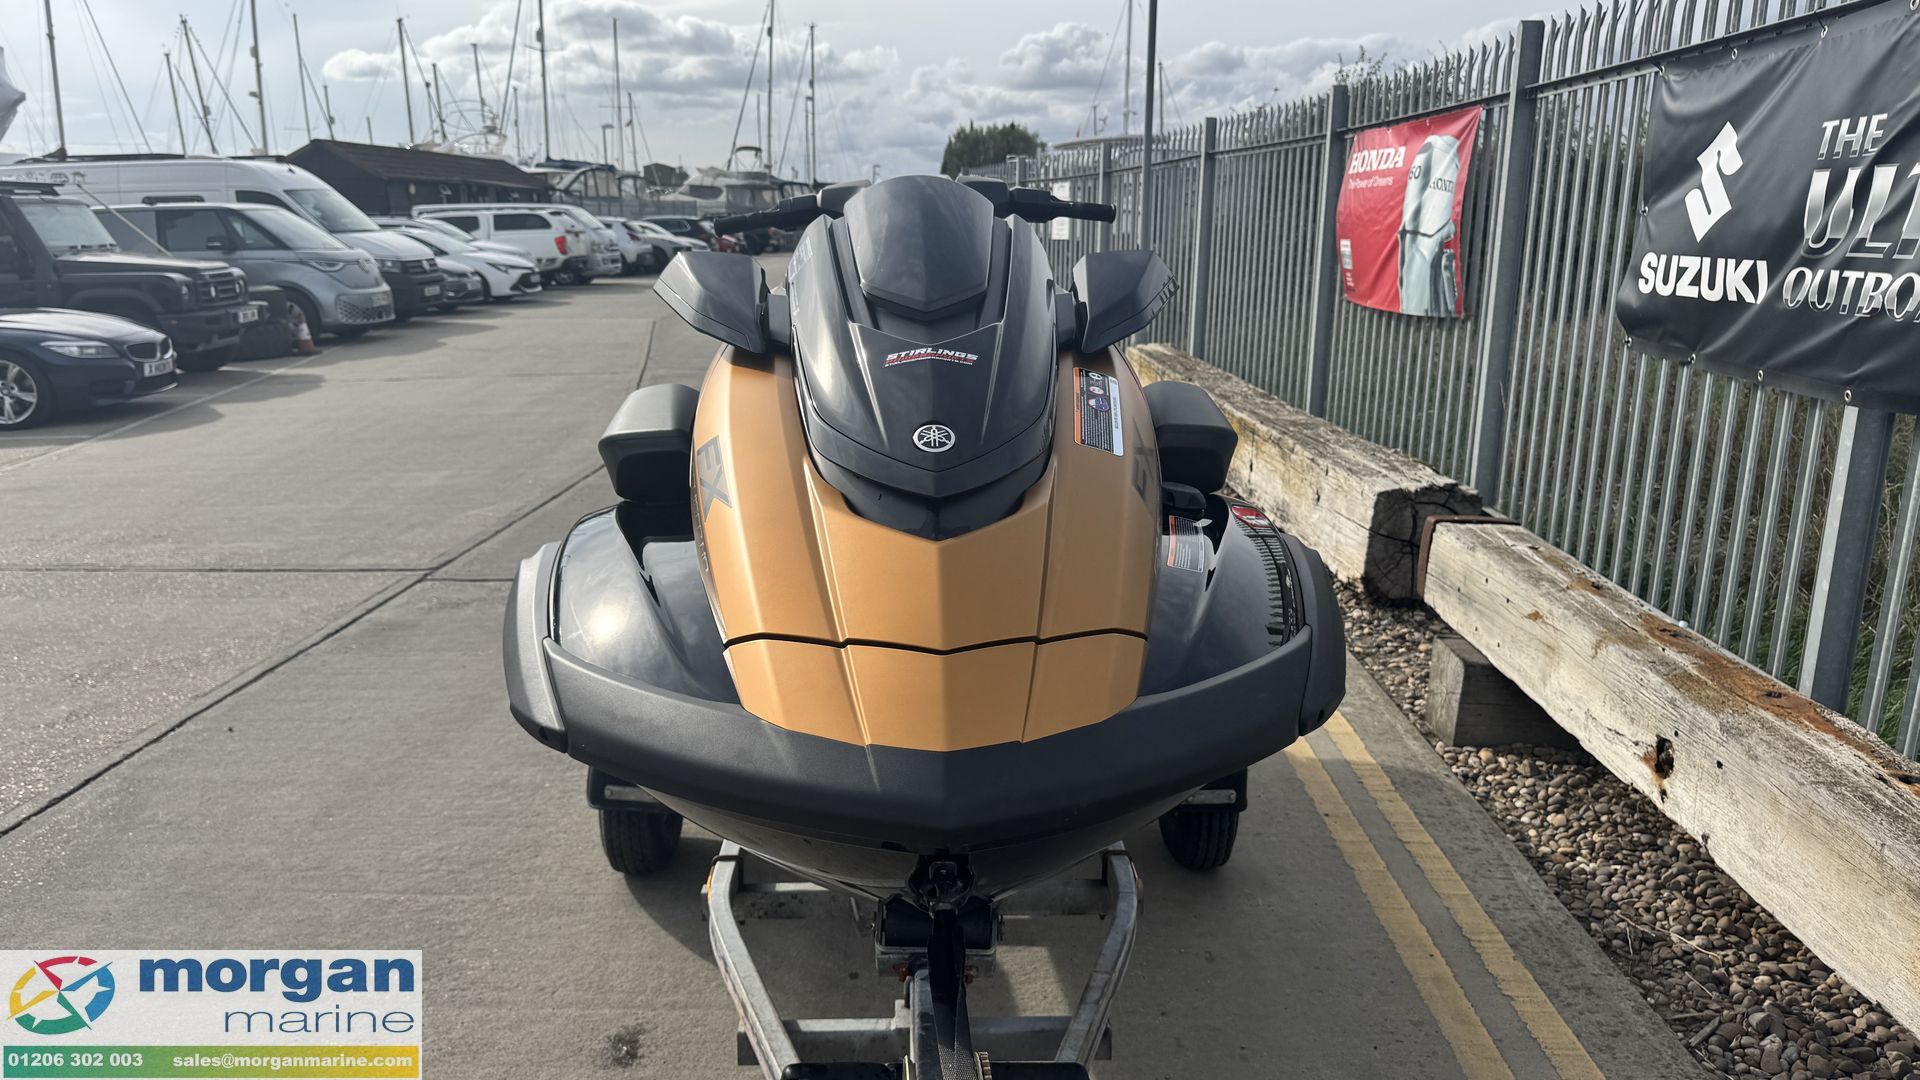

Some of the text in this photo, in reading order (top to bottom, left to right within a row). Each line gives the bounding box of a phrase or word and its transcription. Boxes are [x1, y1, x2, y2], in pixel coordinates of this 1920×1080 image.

[1348, 146, 1407, 174] HONDA
[1817, 113, 1888, 161] THE
[1638, 251, 1768, 305] SUZUKI
[1783, 266, 1920, 323] OUTBO
[886, 347, 979, 361] STIRLINGS
